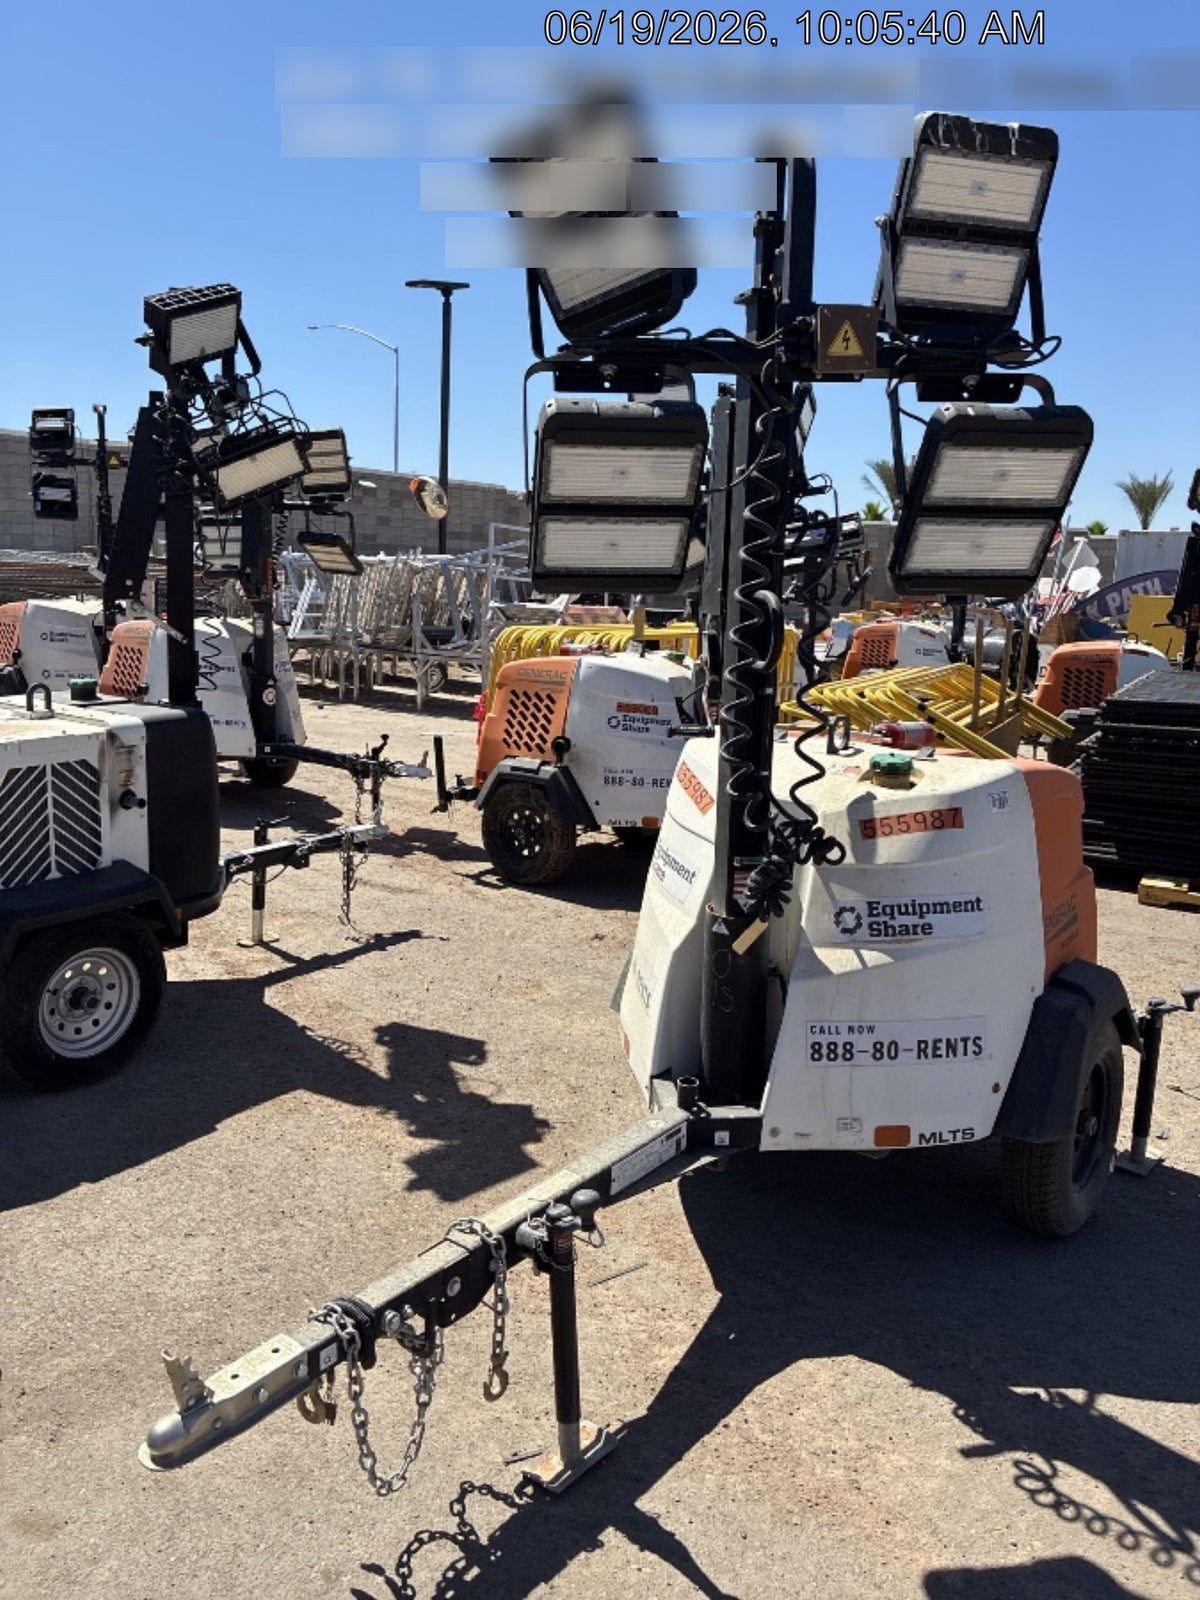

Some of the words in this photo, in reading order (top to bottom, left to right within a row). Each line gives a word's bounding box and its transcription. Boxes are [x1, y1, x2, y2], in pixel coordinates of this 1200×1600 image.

[603, 776, 673, 789] 888-80-REN
[863, 806, 961, 839] 555987
[866, 896, 984, 920] Equipment
[867, 921, 934, 938] Share
[809, 1025, 842, 1036] CALL
[847, 1024, 876, 1035] NOW
[809, 1036, 983, 1063] 888-80-RENTS
[918, 1127, 976, 1145] MLTS
